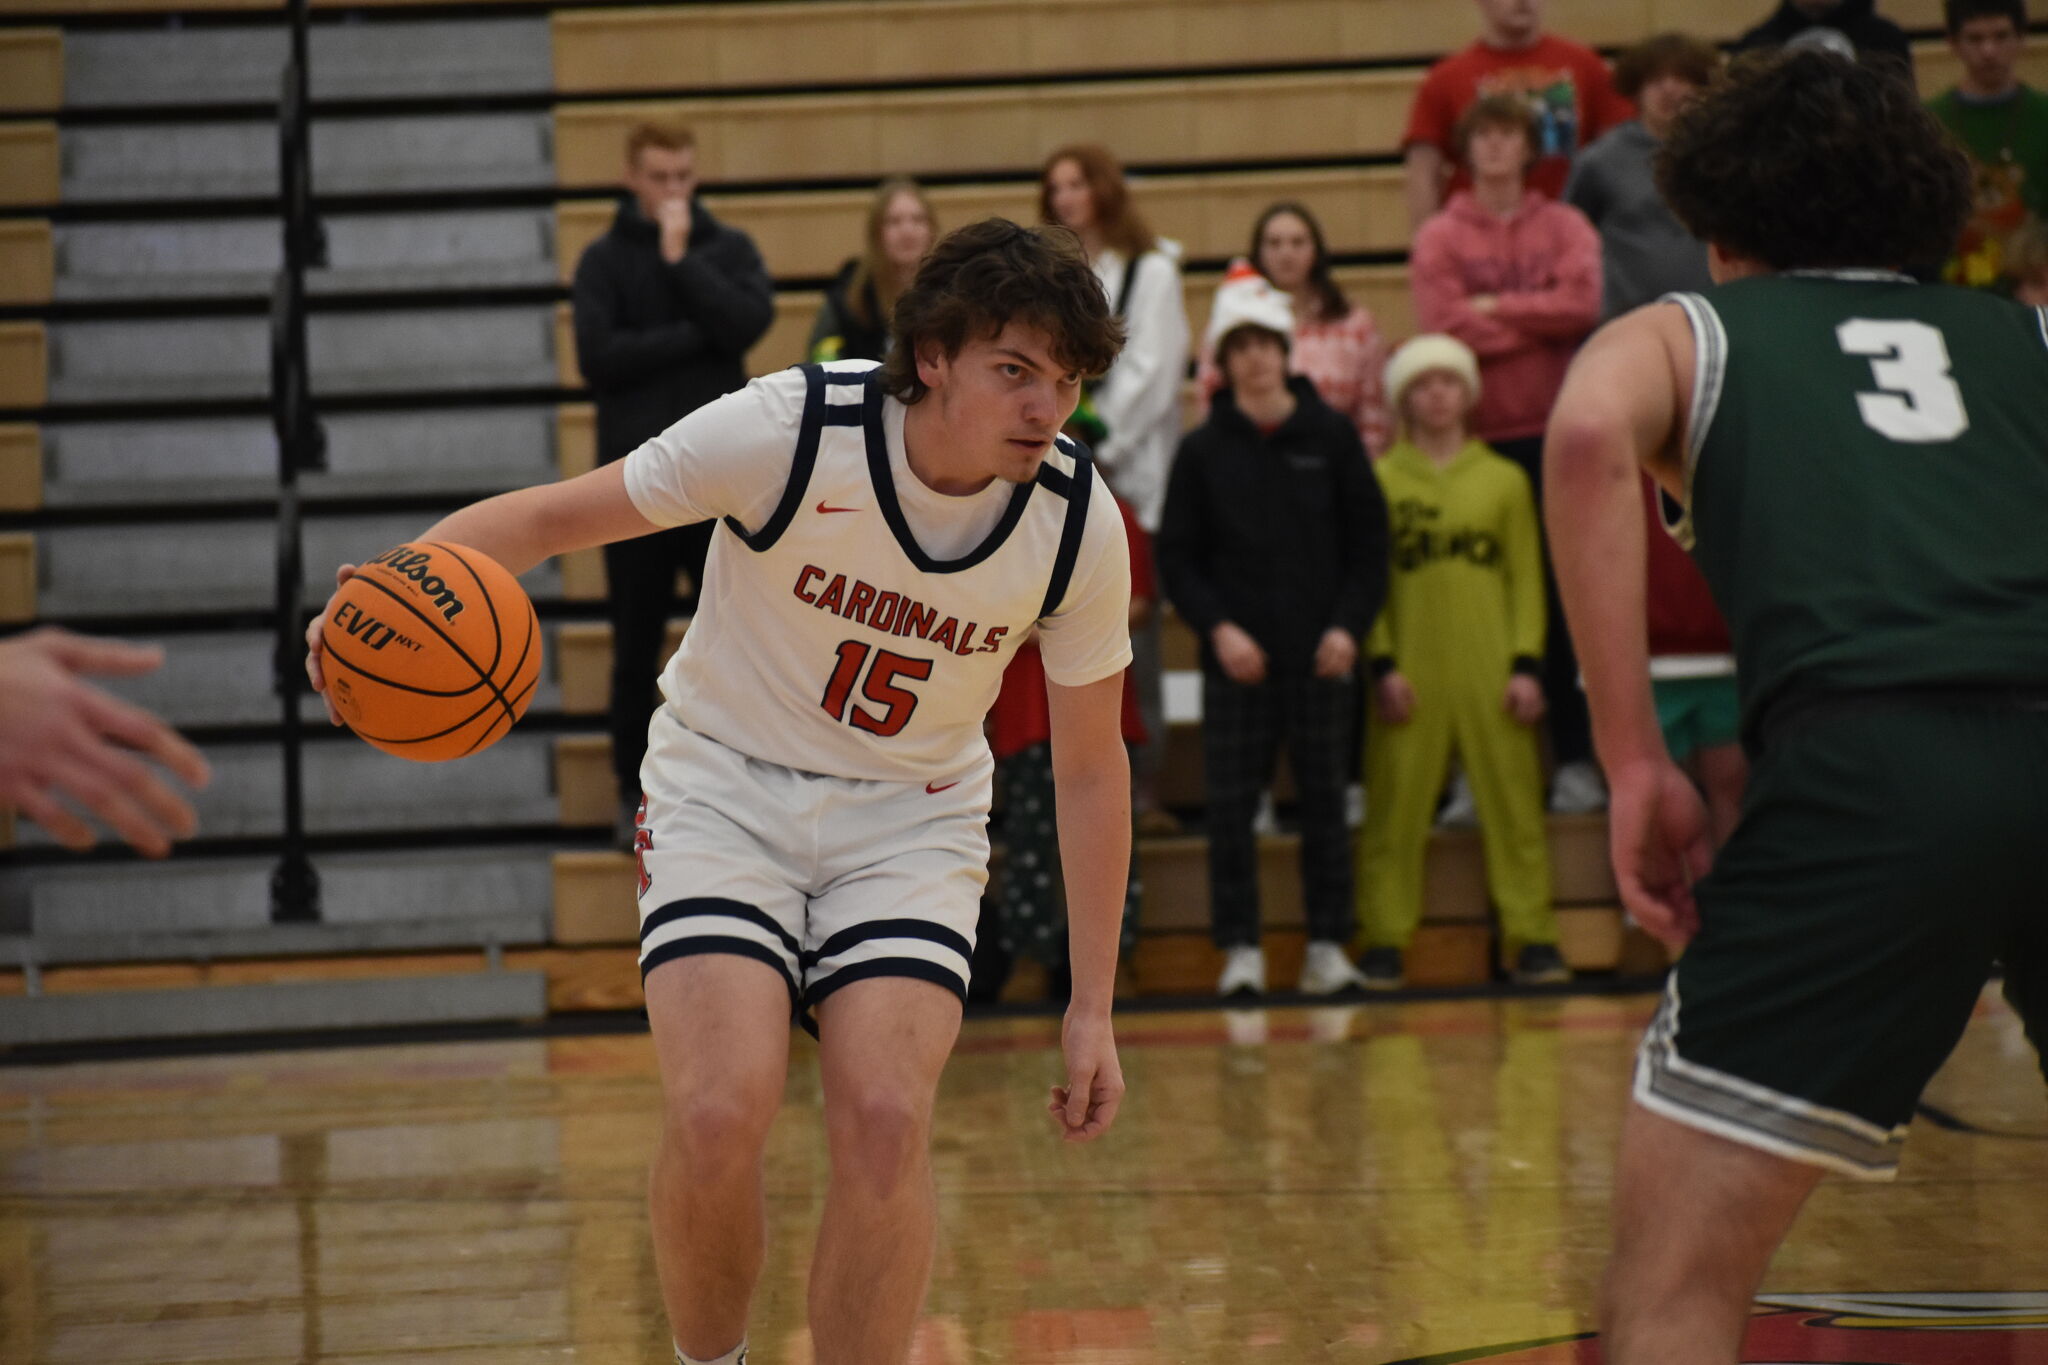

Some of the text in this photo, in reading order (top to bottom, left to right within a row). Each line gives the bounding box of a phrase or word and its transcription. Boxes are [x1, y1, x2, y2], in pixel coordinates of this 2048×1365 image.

[1835, 316, 1970, 444] 3
[333, 600, 424, 653] EVO NXT
[366, 547, 465, 622] Wilson
[793, 563, 1009, 656] CARDINALS
[820, 639, 934, 738] 15
